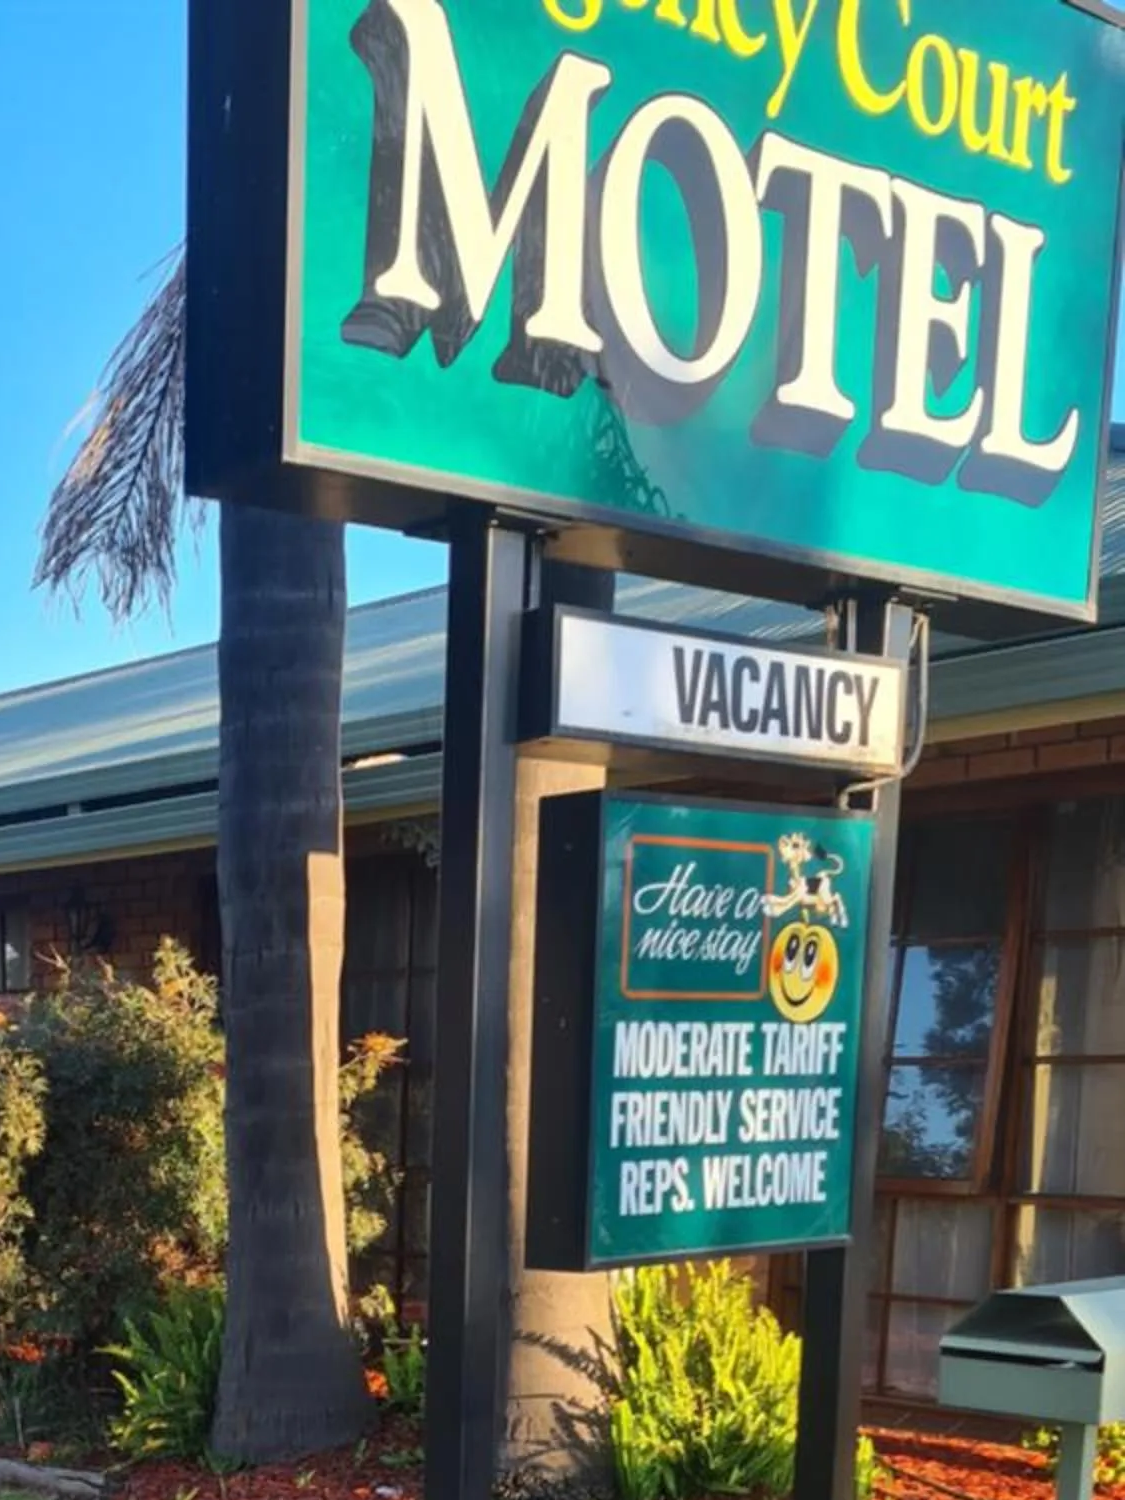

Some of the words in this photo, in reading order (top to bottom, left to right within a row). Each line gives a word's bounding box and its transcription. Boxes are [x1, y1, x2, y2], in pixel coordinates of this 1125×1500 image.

[837, 0, 1077, 184] Court
[375, 0, 1080, 473] MOTEL
[673, 645, 879, 747] VACANCY
[633, 860, 734, 919] Have
[734, 886, 763, 920] a
[635, 919, 701, 961] nice
[698, 923, 762, 976] stay
[613, 1020, 755, 1079] MODERATE
[761, 1021, 847, 1076] TARIFF
[610, 1089, 734, 1149] FRIENDLY
[739, 1087, 843, 1143] SERVICE
[619, 1155, 695, 1217] REPS.
[702, 1151, 828, 1211] WELCOME
